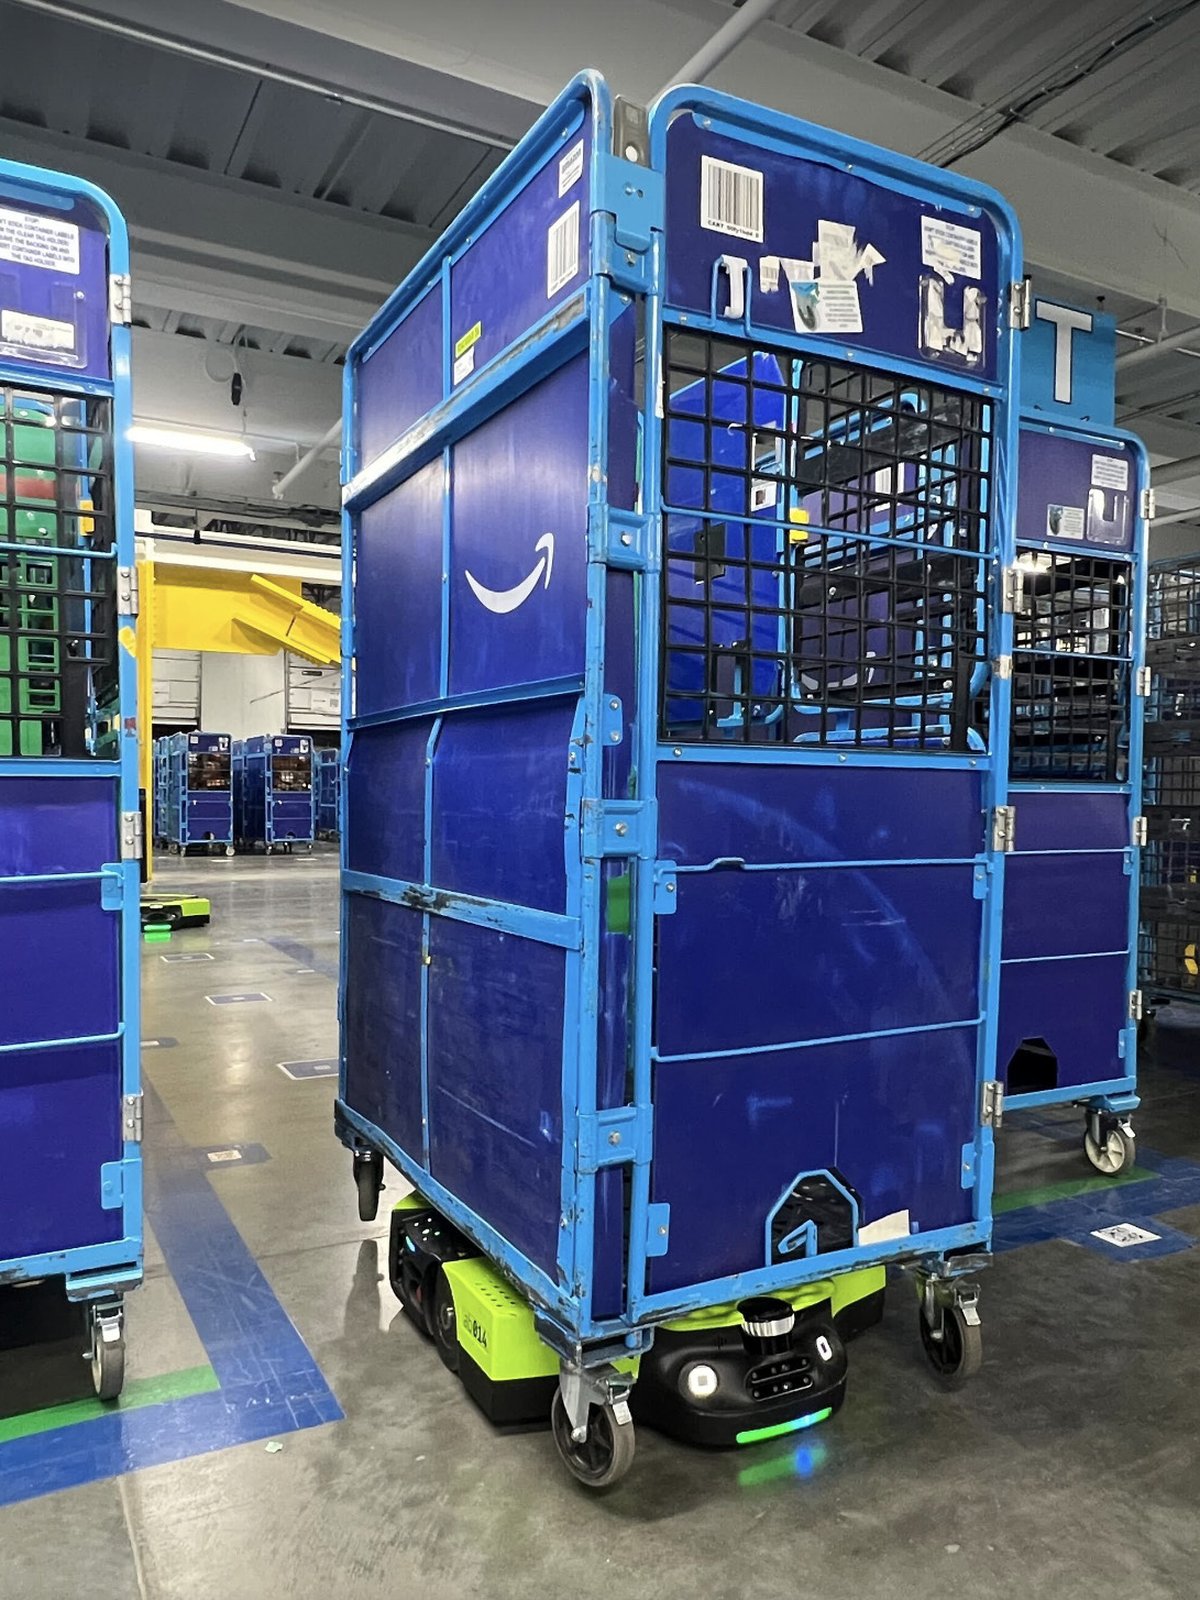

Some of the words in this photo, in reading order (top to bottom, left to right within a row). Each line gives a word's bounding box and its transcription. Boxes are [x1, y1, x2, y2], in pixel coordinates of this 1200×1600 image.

[17, 230, 34, 239] CLEAR
[36, 234, 46, 242] TAG
[55, 231, 74, 240] LABELS
[12, 252, 21, 260] THE
[23, 254, 33, 262] TAG
[42, 252, 62, 261] LABELS
[1035, 299, 1093, 404] T
